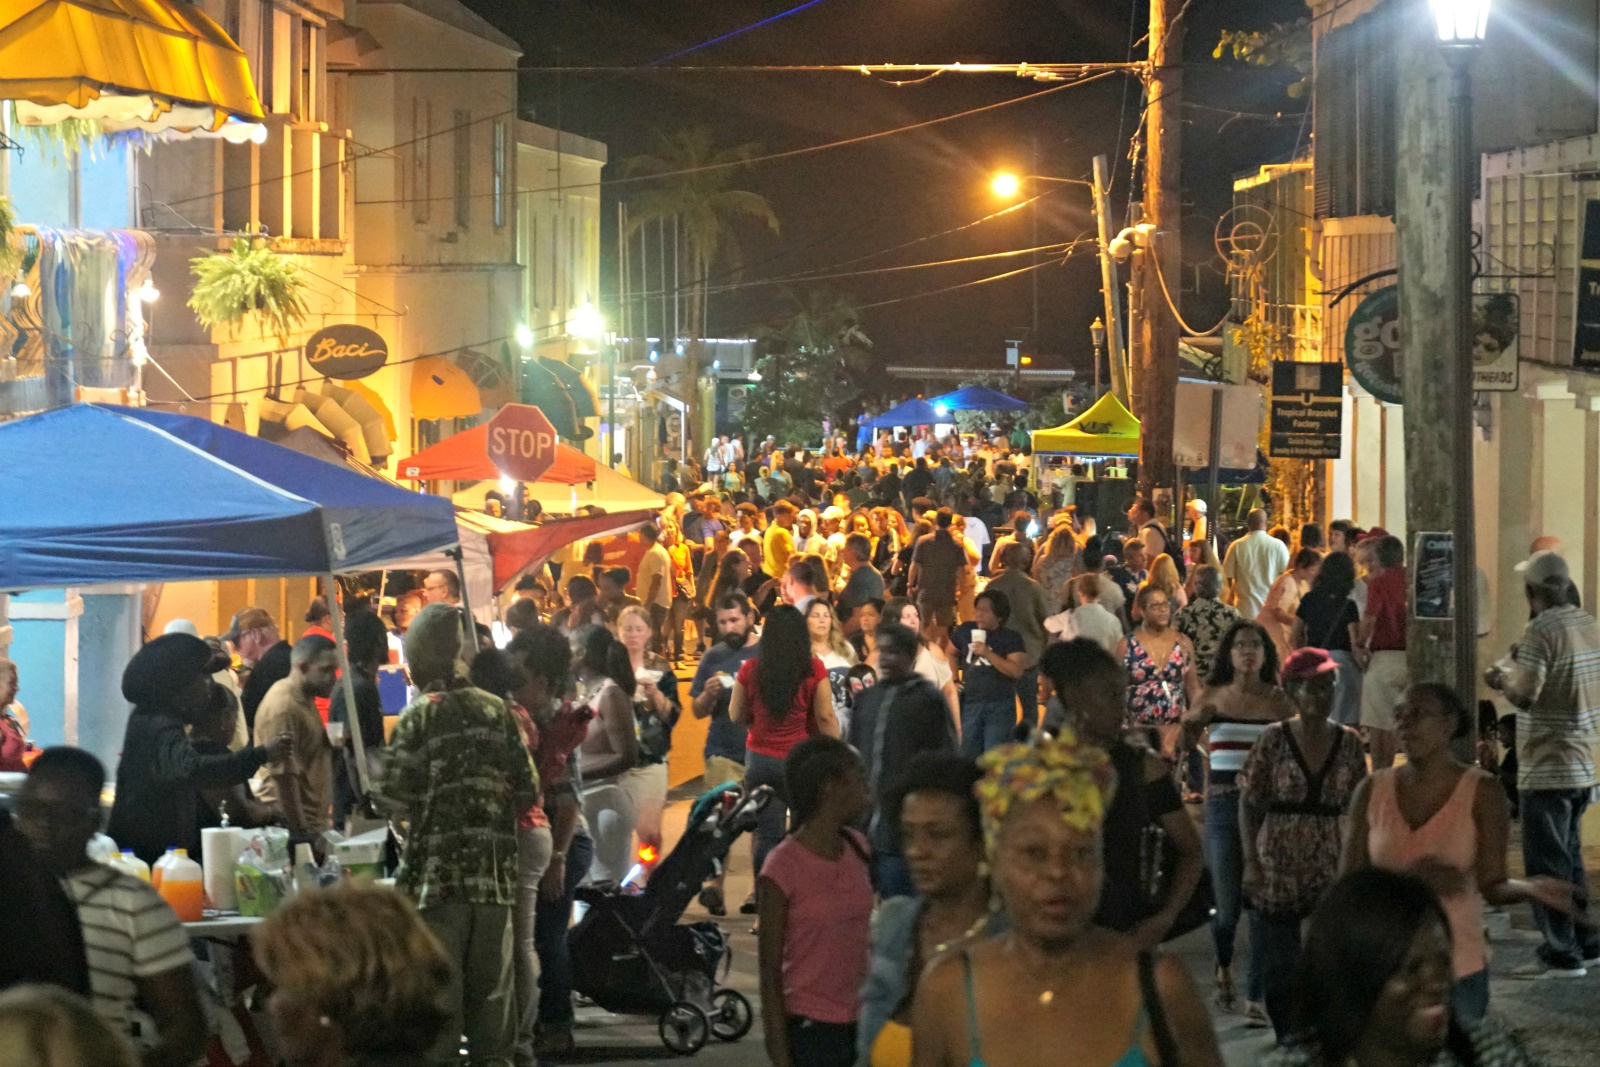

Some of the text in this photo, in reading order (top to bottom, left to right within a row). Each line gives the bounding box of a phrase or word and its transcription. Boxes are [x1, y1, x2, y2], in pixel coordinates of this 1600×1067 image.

[309, 338, 387, 362] Baci
[1473, 371, 1513, 384] THEADS
[1277, 408, 1338, 417] Tropical Bracelet
[1293, 419, 1320, 429] Factory
[492, 427, 552, 459] STOP
